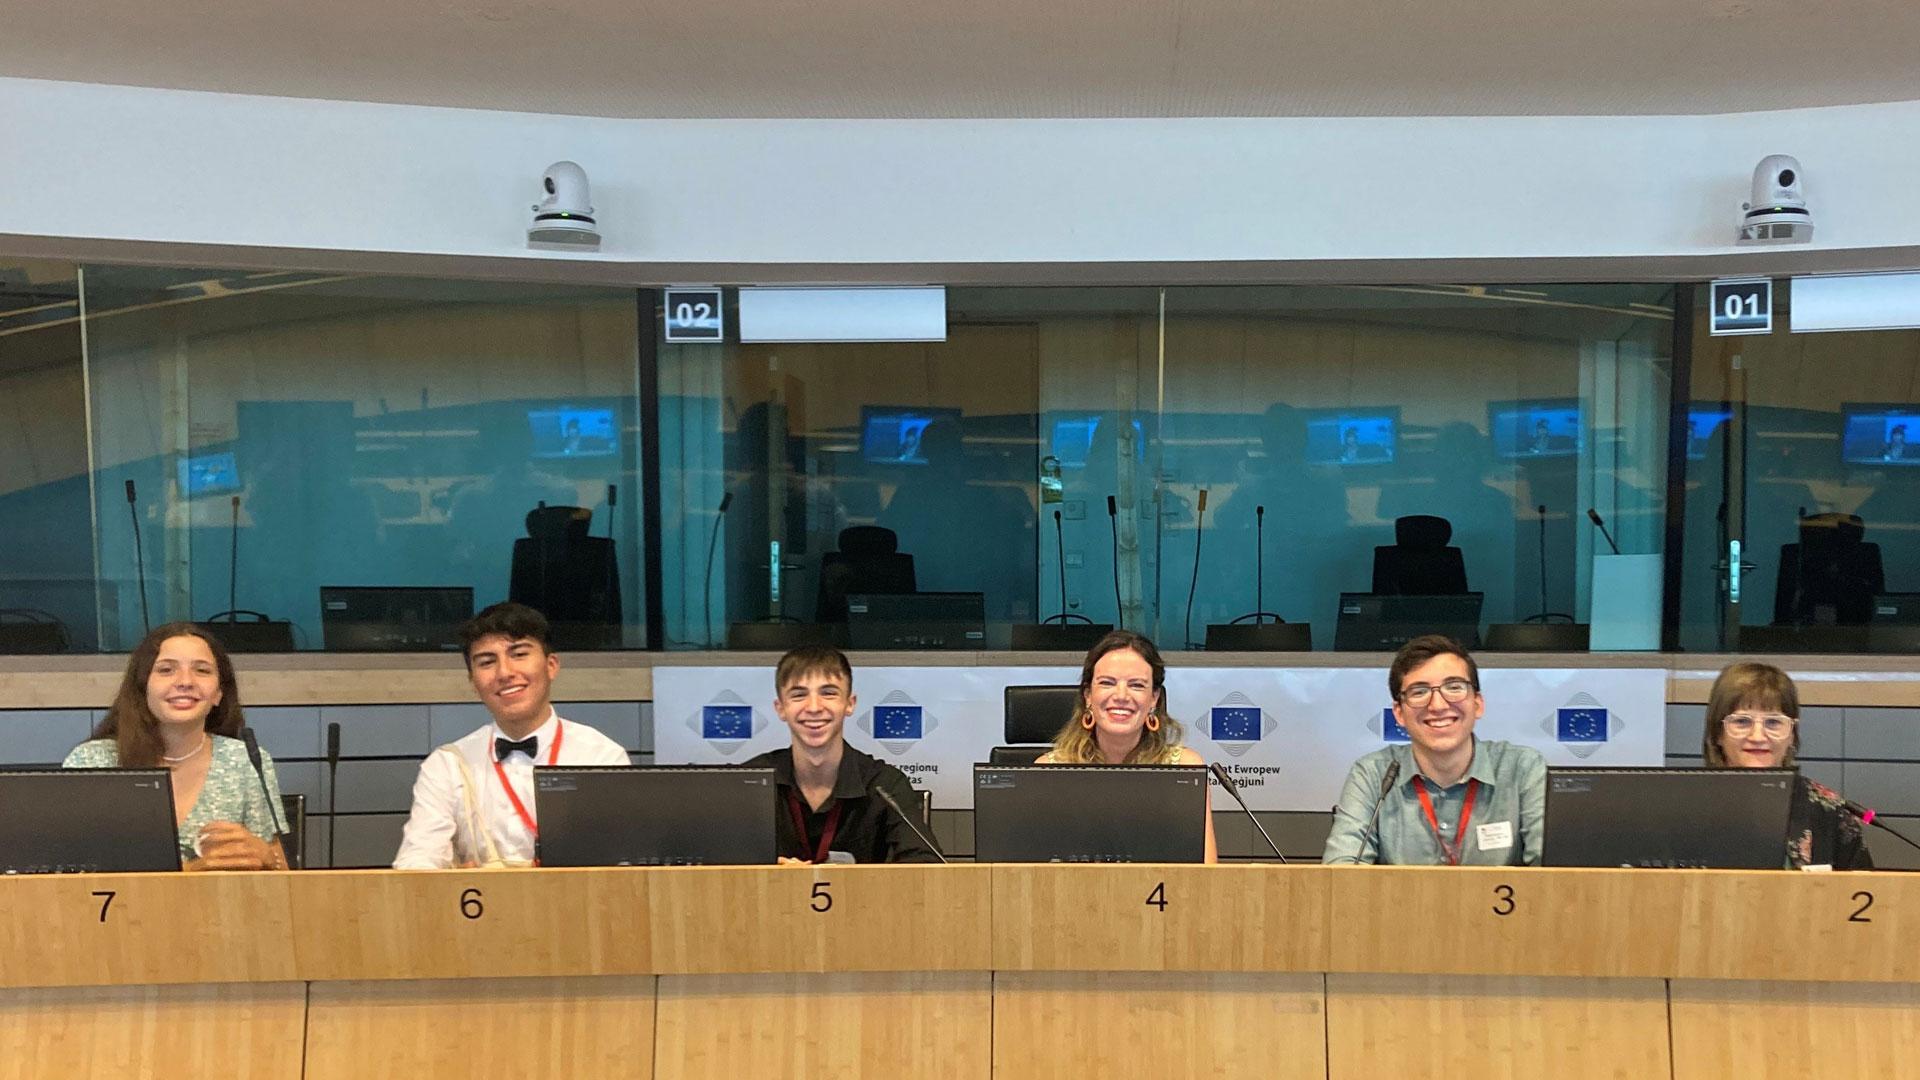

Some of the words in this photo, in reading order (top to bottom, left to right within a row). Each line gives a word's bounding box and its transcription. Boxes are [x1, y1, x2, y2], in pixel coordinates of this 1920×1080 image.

[675, 301, 712, 328] 02
[1724, 293, 1760, 319] 01
[1234, 764, 1280, 775] Ewropew
[91, 891, 116, 923] 7
[460, 888, 484, 920] 6
[810, 882, 833, 913] 5
[1145, 881, 1169, 912] 4
[1492, 884, 1516, 916] 3
[1847, 891, 1875, 923] 2
